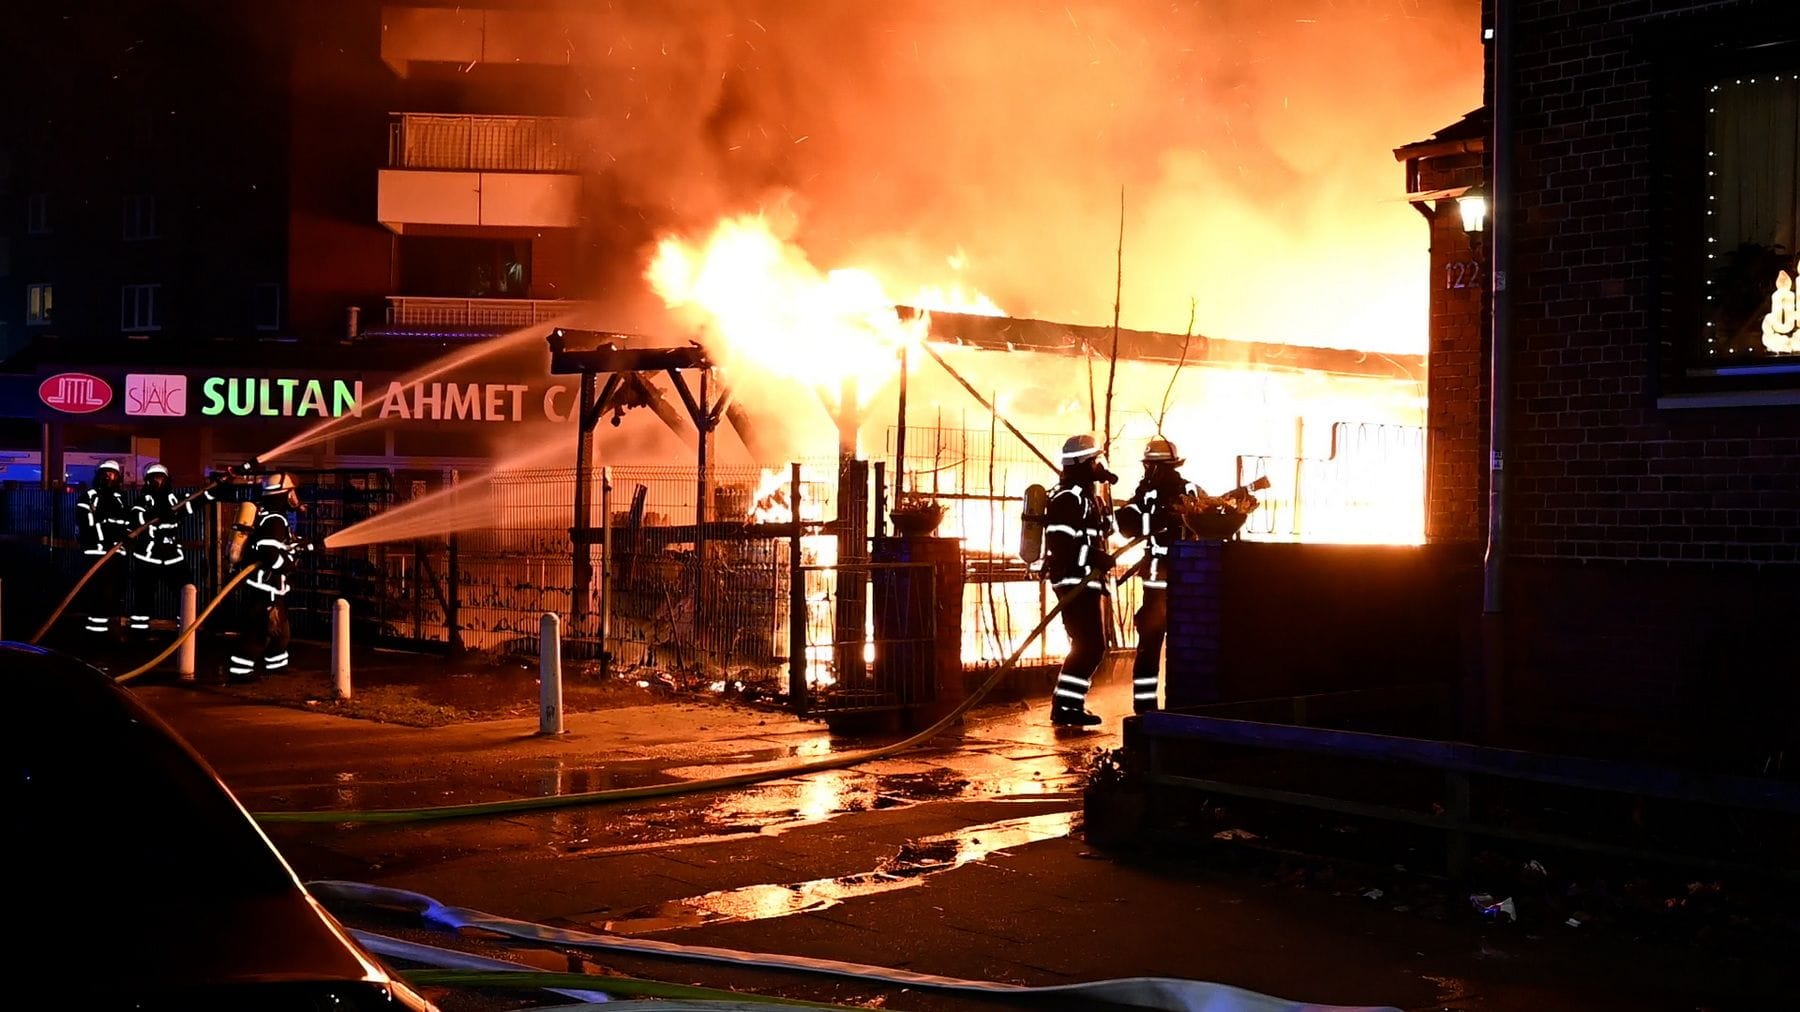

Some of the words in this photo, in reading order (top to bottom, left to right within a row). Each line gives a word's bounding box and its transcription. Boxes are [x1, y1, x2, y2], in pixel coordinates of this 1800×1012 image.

[1445, 260, 1480, 289] 122
[200, 376, 364, 418] SULTAN
[378, 381, 529, 422] AHMET
